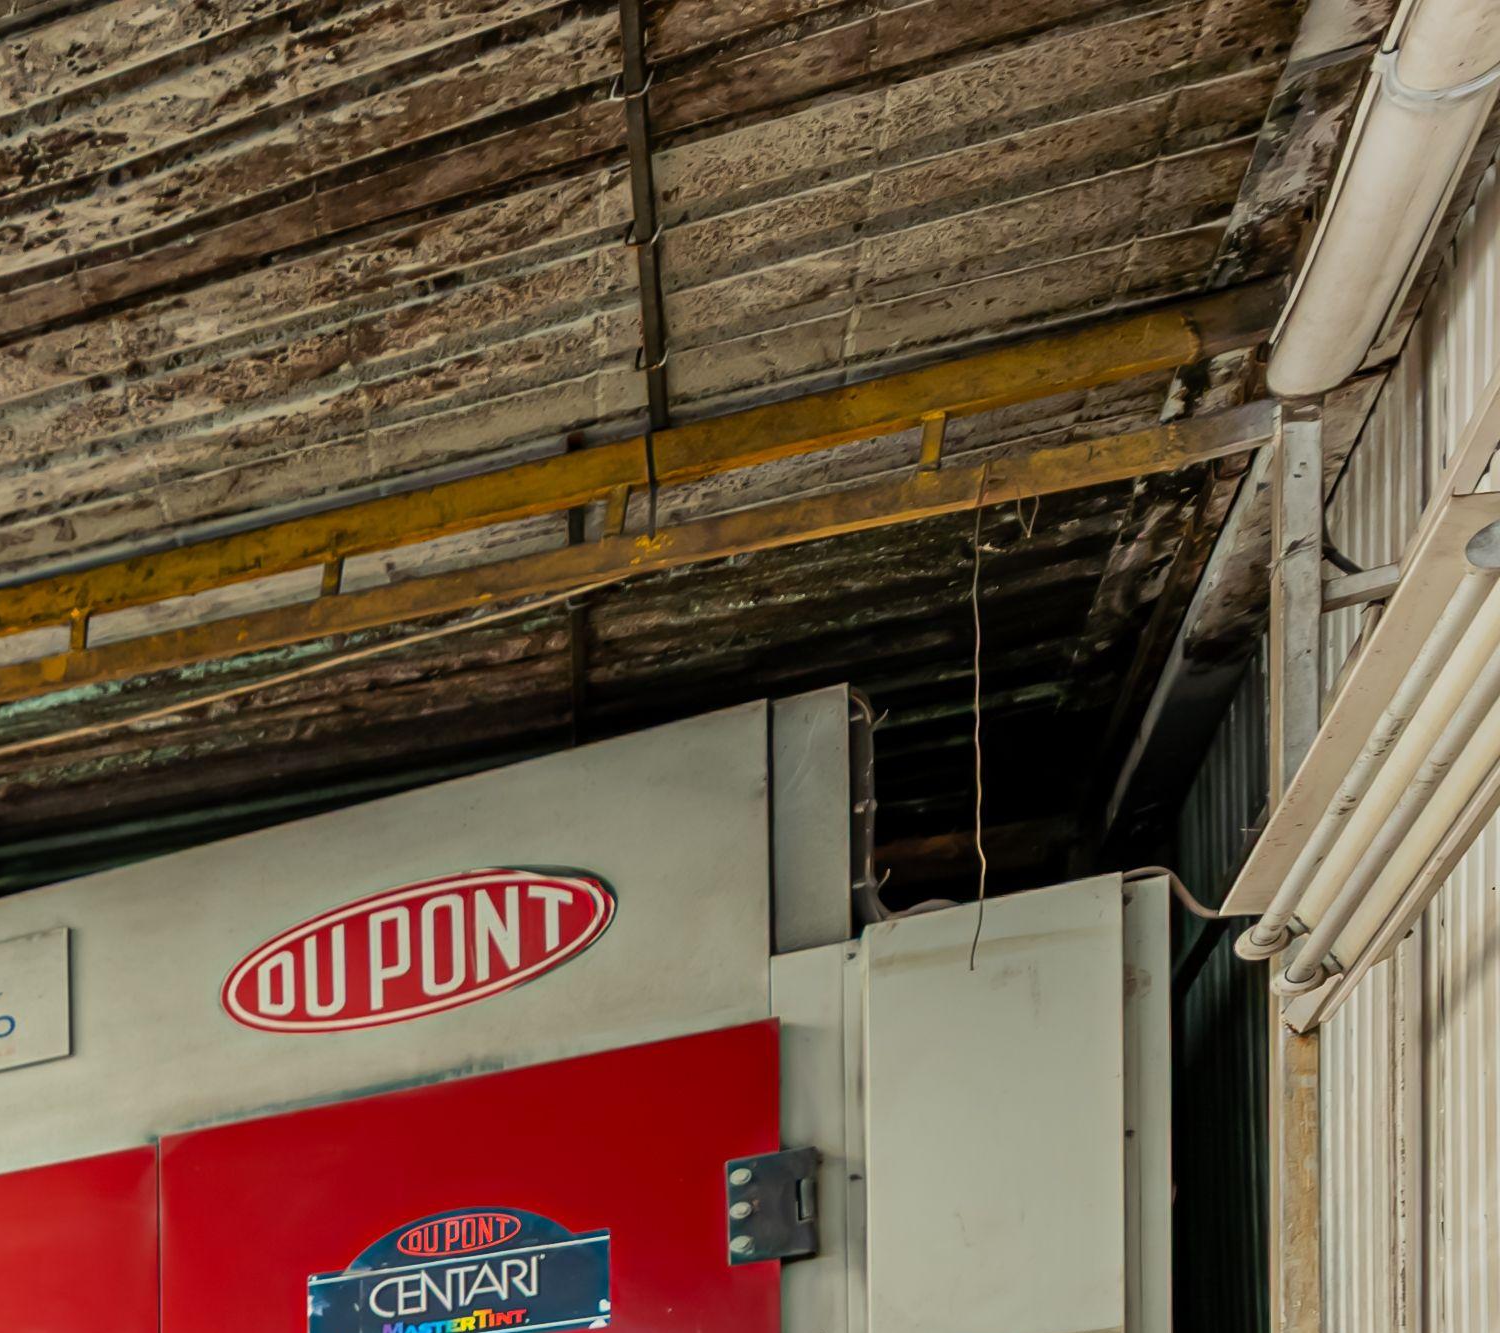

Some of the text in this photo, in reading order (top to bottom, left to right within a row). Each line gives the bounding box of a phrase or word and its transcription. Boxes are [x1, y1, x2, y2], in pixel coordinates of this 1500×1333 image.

[257, 885, 574, 1017] DU PONT
[408, 1216, 511, 1253] DU PONT
[368, 1255, 541, 1318] CENTARI
